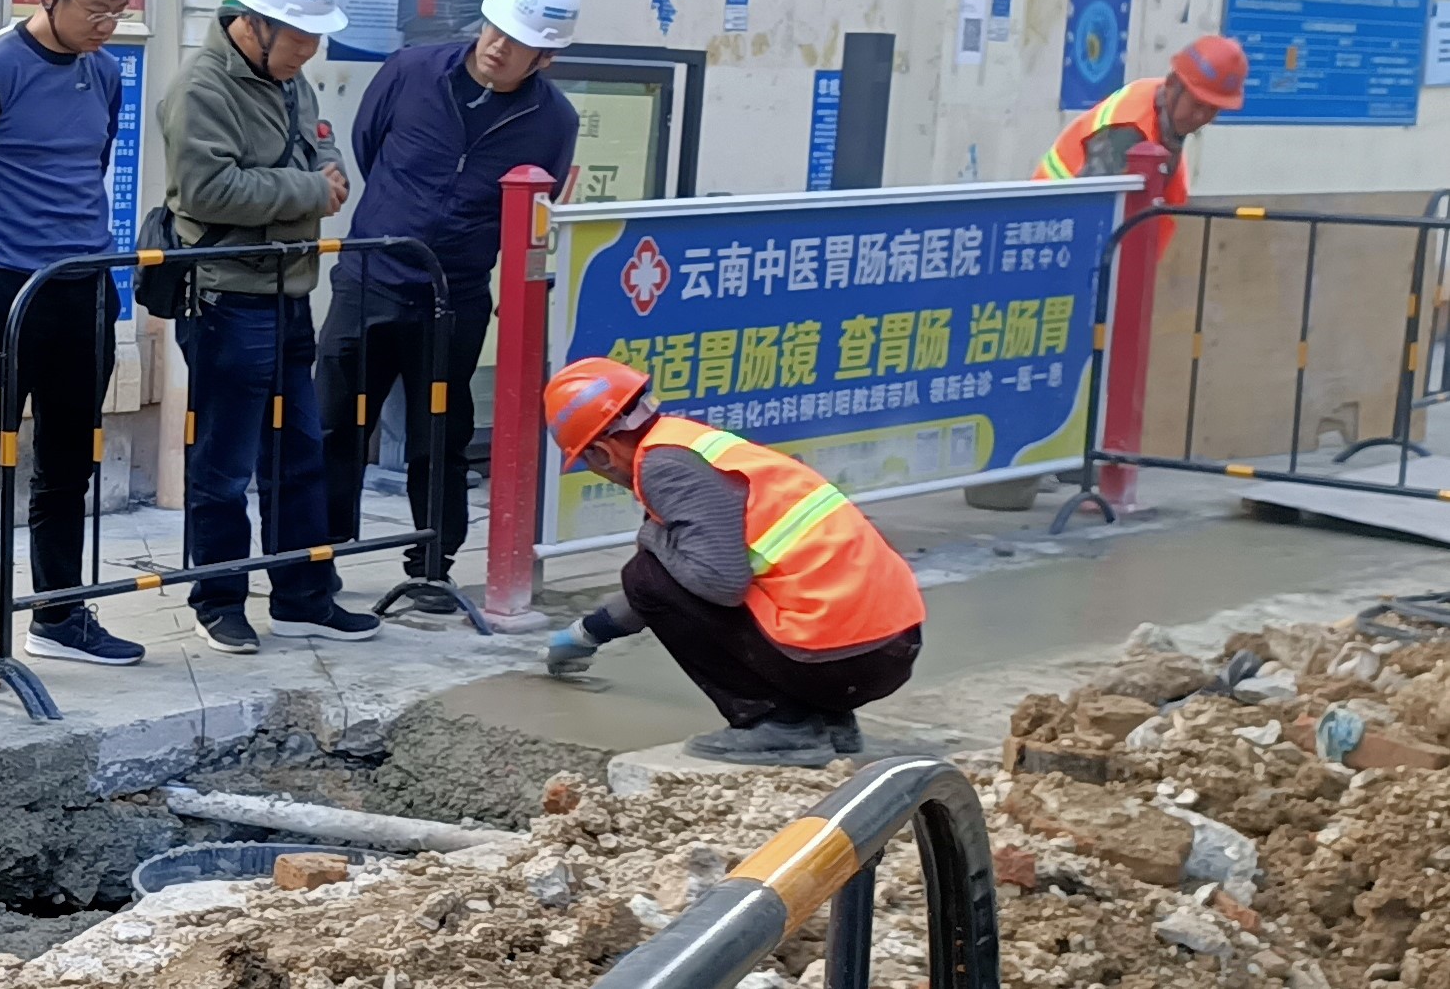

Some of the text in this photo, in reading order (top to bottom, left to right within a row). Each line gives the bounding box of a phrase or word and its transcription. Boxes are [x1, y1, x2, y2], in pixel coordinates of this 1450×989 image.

[678, 225, 984, 301] 云南中医胃肠病医院
[835, 309, 953, 382] 查胃肠
[964, 295, 1075, 365] 治肠胃
